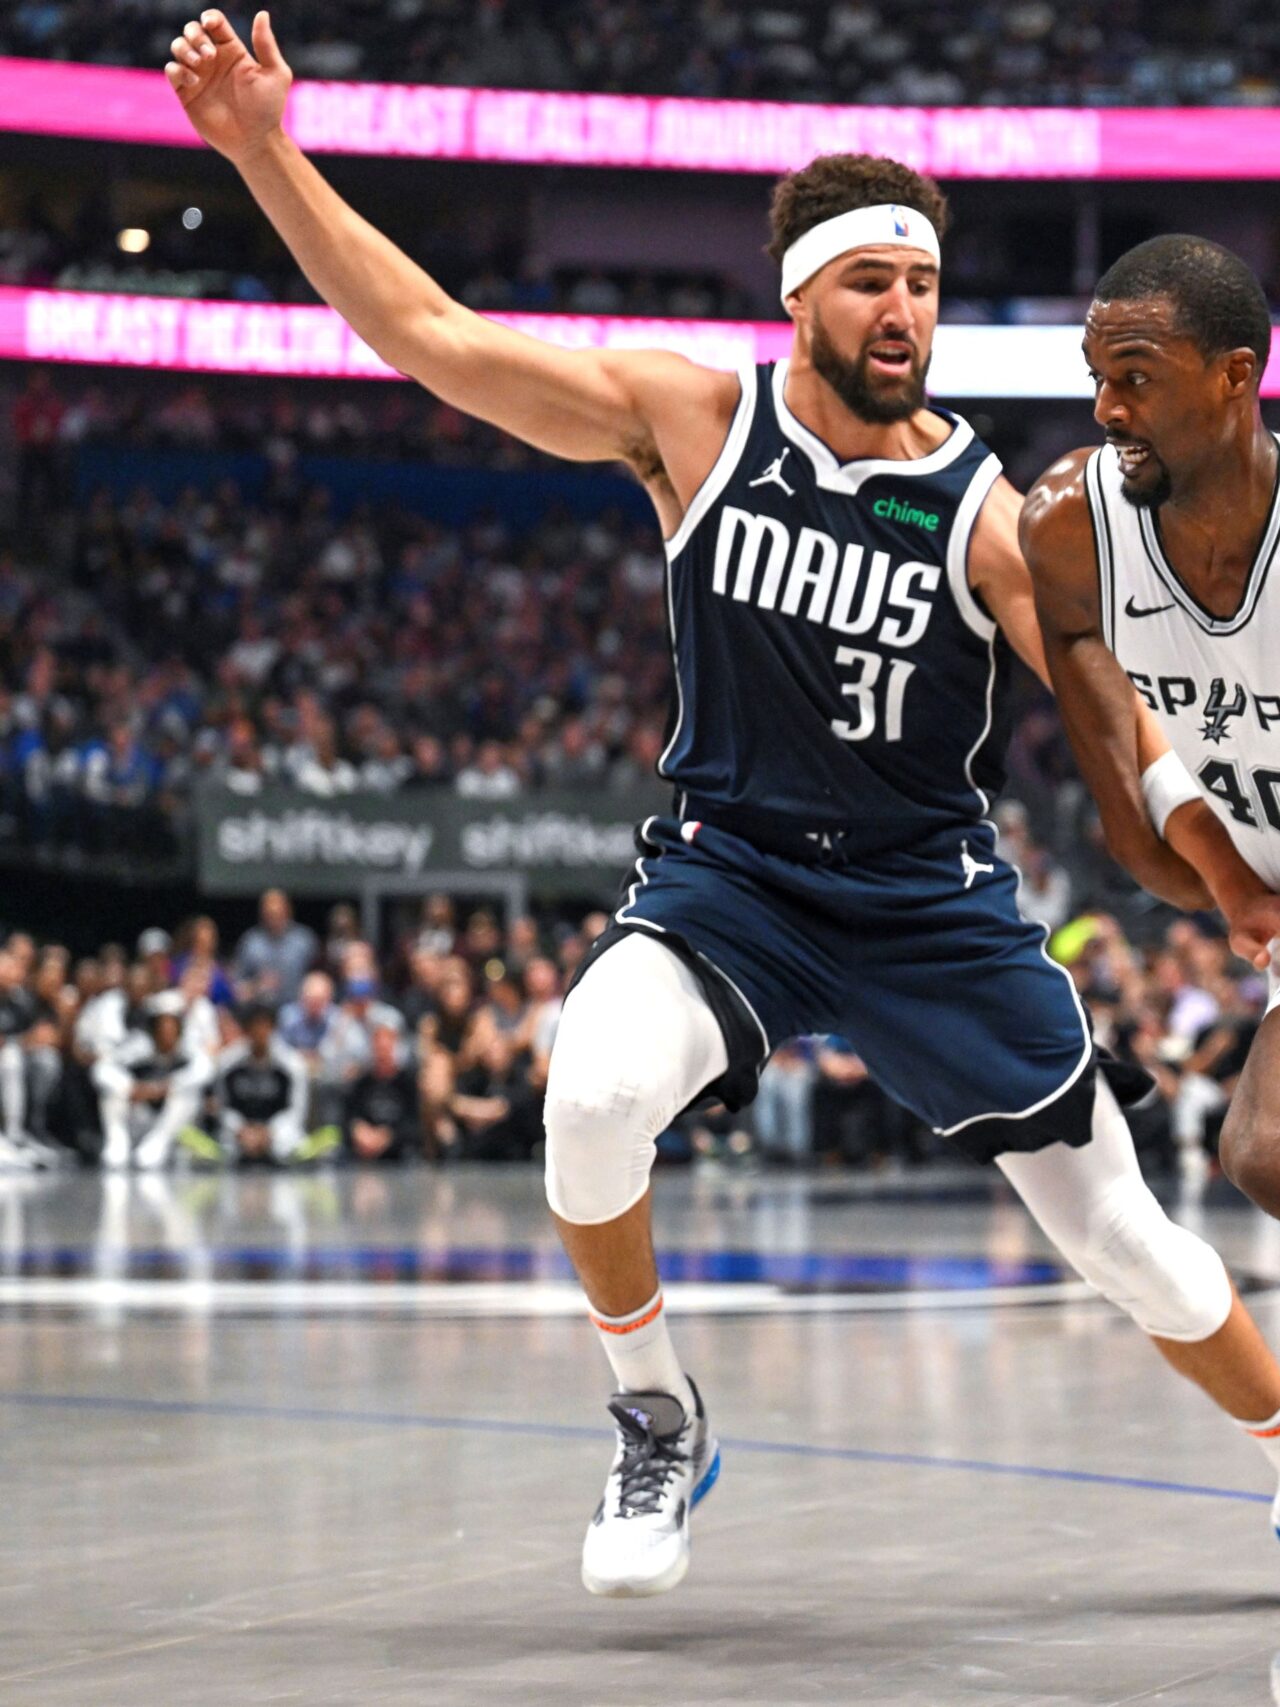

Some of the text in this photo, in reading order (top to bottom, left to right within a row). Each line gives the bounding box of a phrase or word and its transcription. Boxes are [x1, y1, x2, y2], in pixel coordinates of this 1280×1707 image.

[873, 496, 940, 532] chime
[712, 505, 942, 648] MAVS
[831, 645, 917, 743] 31
[462, 812, 637, 867] shiftke
